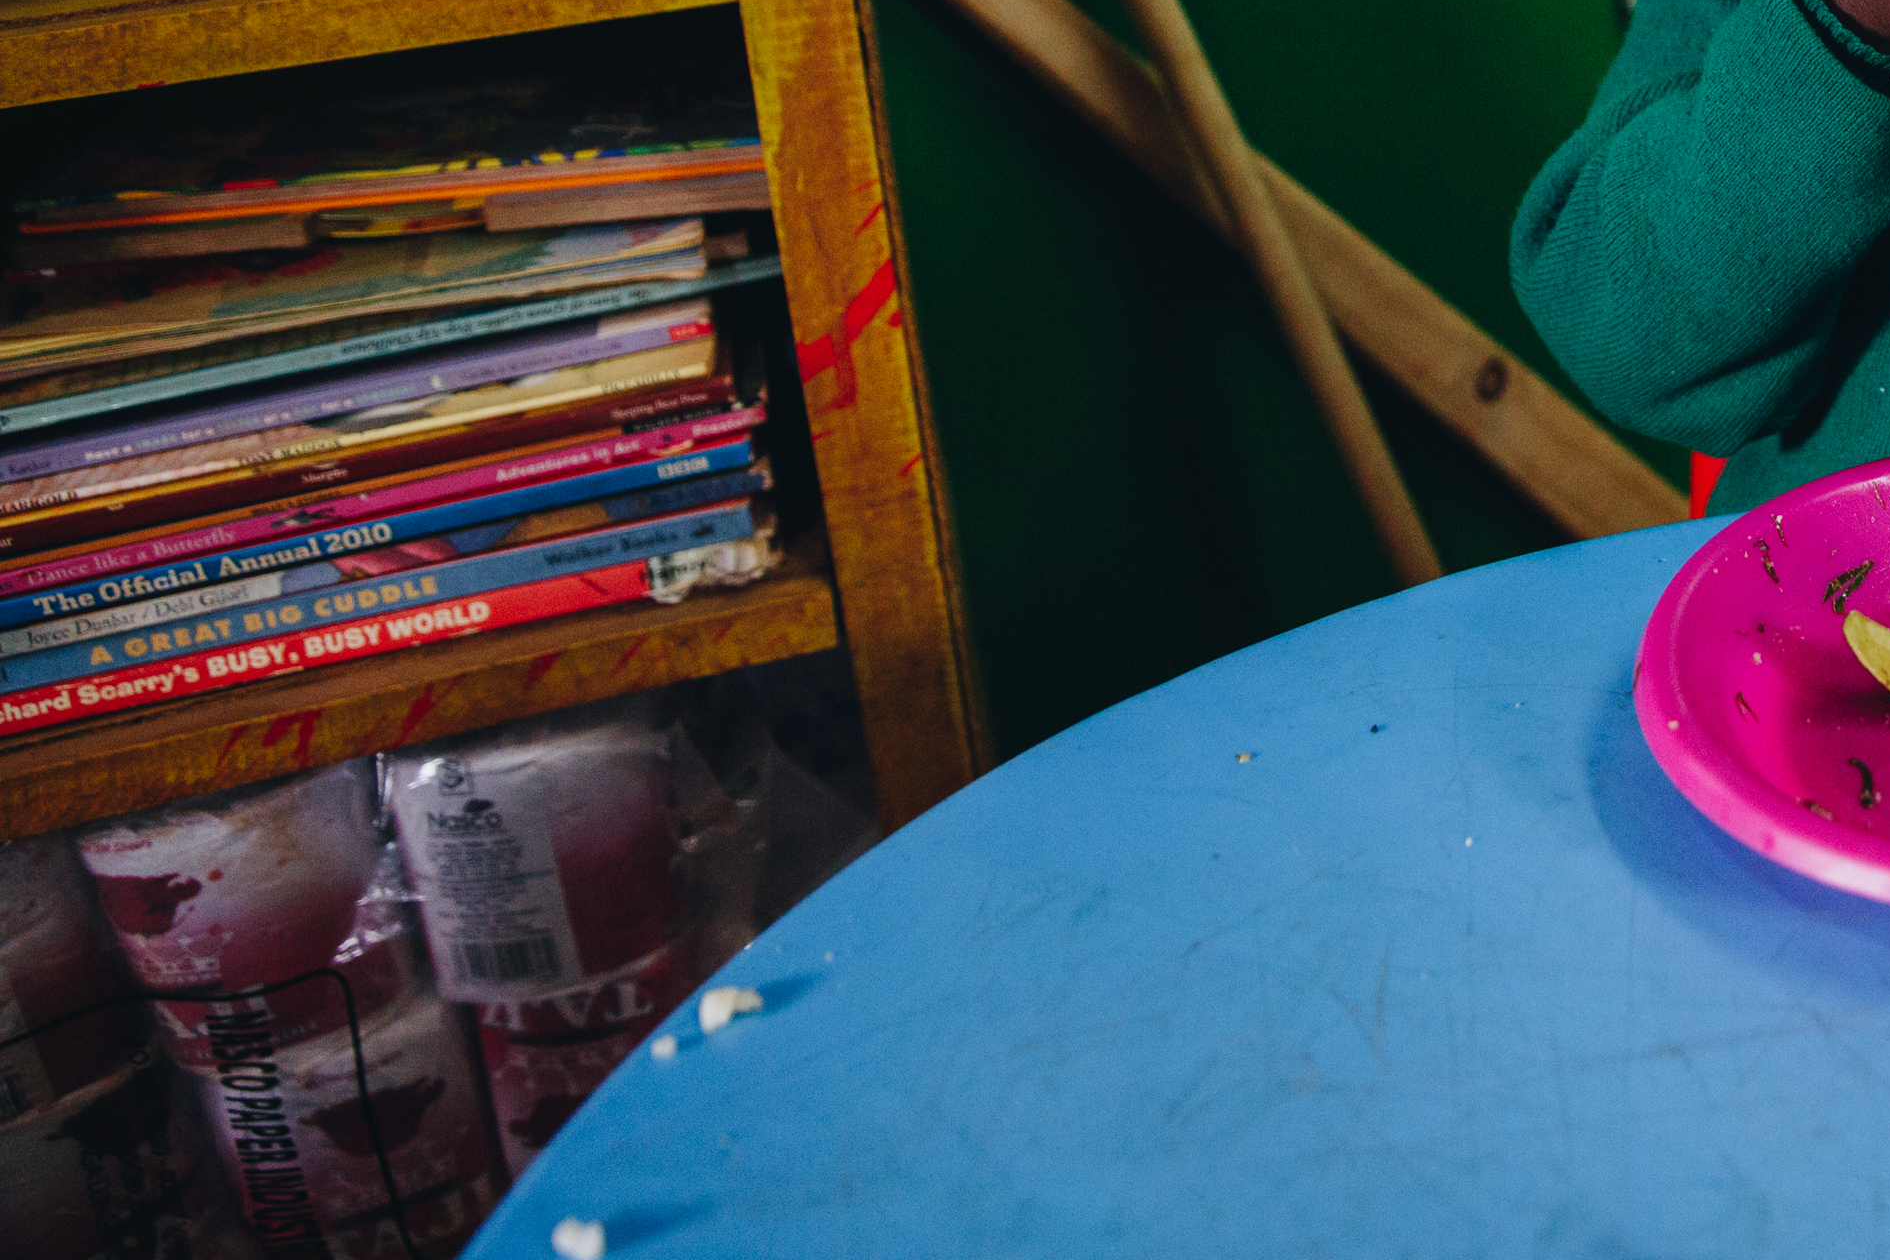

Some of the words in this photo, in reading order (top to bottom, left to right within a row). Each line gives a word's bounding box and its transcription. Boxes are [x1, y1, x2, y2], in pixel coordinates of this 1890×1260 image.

[27, 560, 90, 588] Dance
[93, 551, 131, 573] like
[135, 550, 148, 565] a
[152, 527, 238, 559] Butterfly
[495, 452, 591, 483] Adventures
[593, 445, 613, 464] in
[615, 439, 641, 458] Art
[34, 586, 95, 617] The
[98, 563, 206, 603] Official
[218, 537, 321, 577] Annual
[325, 522, 393, 555] 2010
[90, 644, 113, 666] A
[124, 619, 233, 658] GREAT
[243, 603, 303, 632] BIG
[313, 574, 439, 618] CUDDLE
[543, 544, 613, 568] Walker
[619, 529, 679, 551] Books
[26, 623, 70, 650] Joyce
[74, 613, 136, 637] Dunbar
[77, 665, 200, 708] Scarry's
[205, 642, 299, 680] BUSY,
[305, 618, 384, 650] BUSY
[385, 600, 491, 640] WORLD
[205, 1010, 281, 1092] NASCO
[225, 1095, 300, 1165] PAPER
